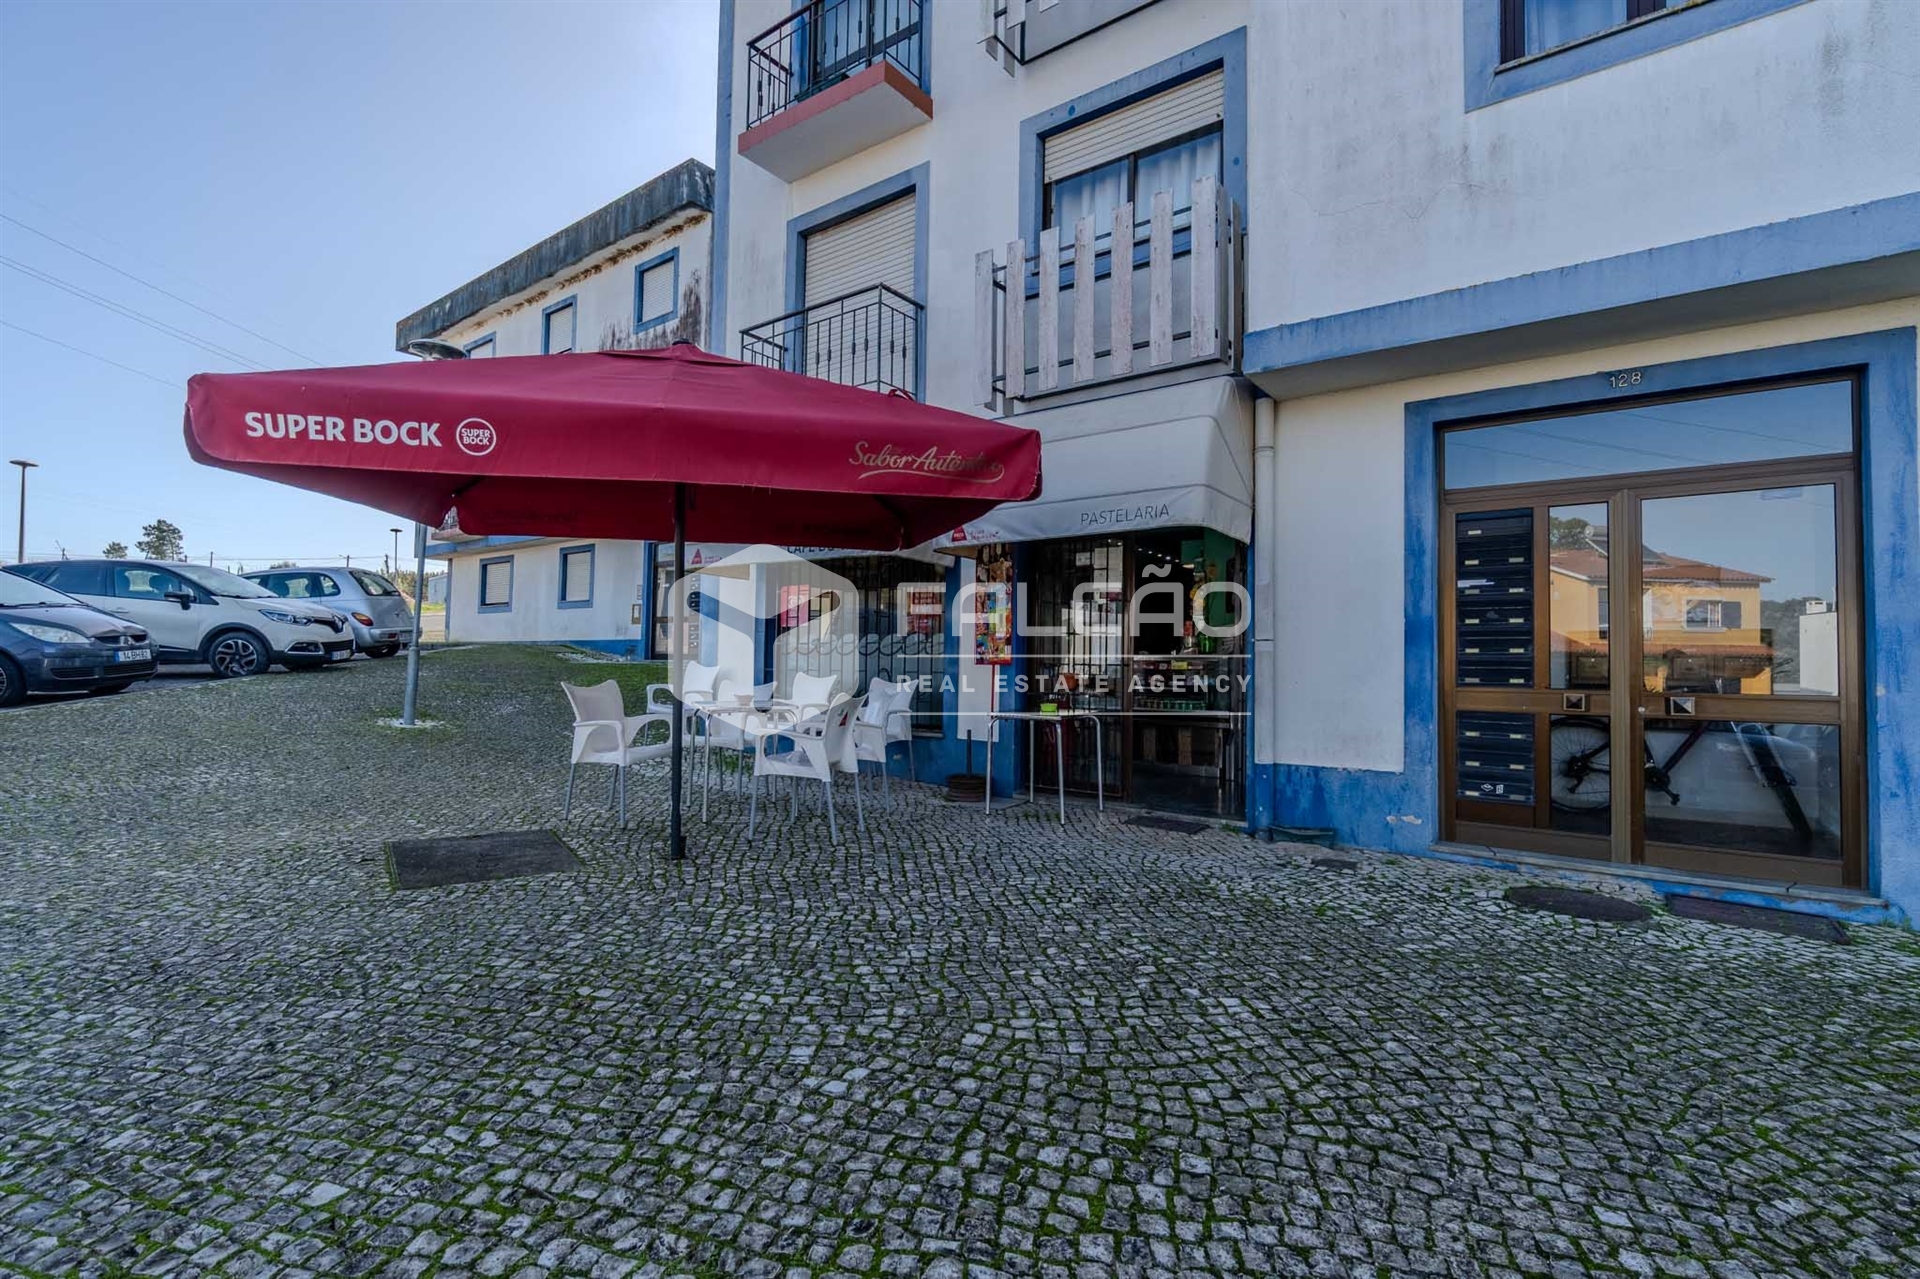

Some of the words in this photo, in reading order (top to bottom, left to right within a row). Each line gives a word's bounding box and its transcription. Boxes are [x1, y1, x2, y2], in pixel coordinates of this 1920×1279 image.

[1610, 371, 1641, 388] 128
[244, 411, 346, 442] SUPER
[353, 418, 443, 448] BOCK
[460, 427, 492, 438] SUPER
[463, 436, 490, 446] BOCK
[848, 440, 913, 469] Sabor
[911, 444, 1004, 474] Autênto
[1080, 503, 1170, 526] PASTELARIA
